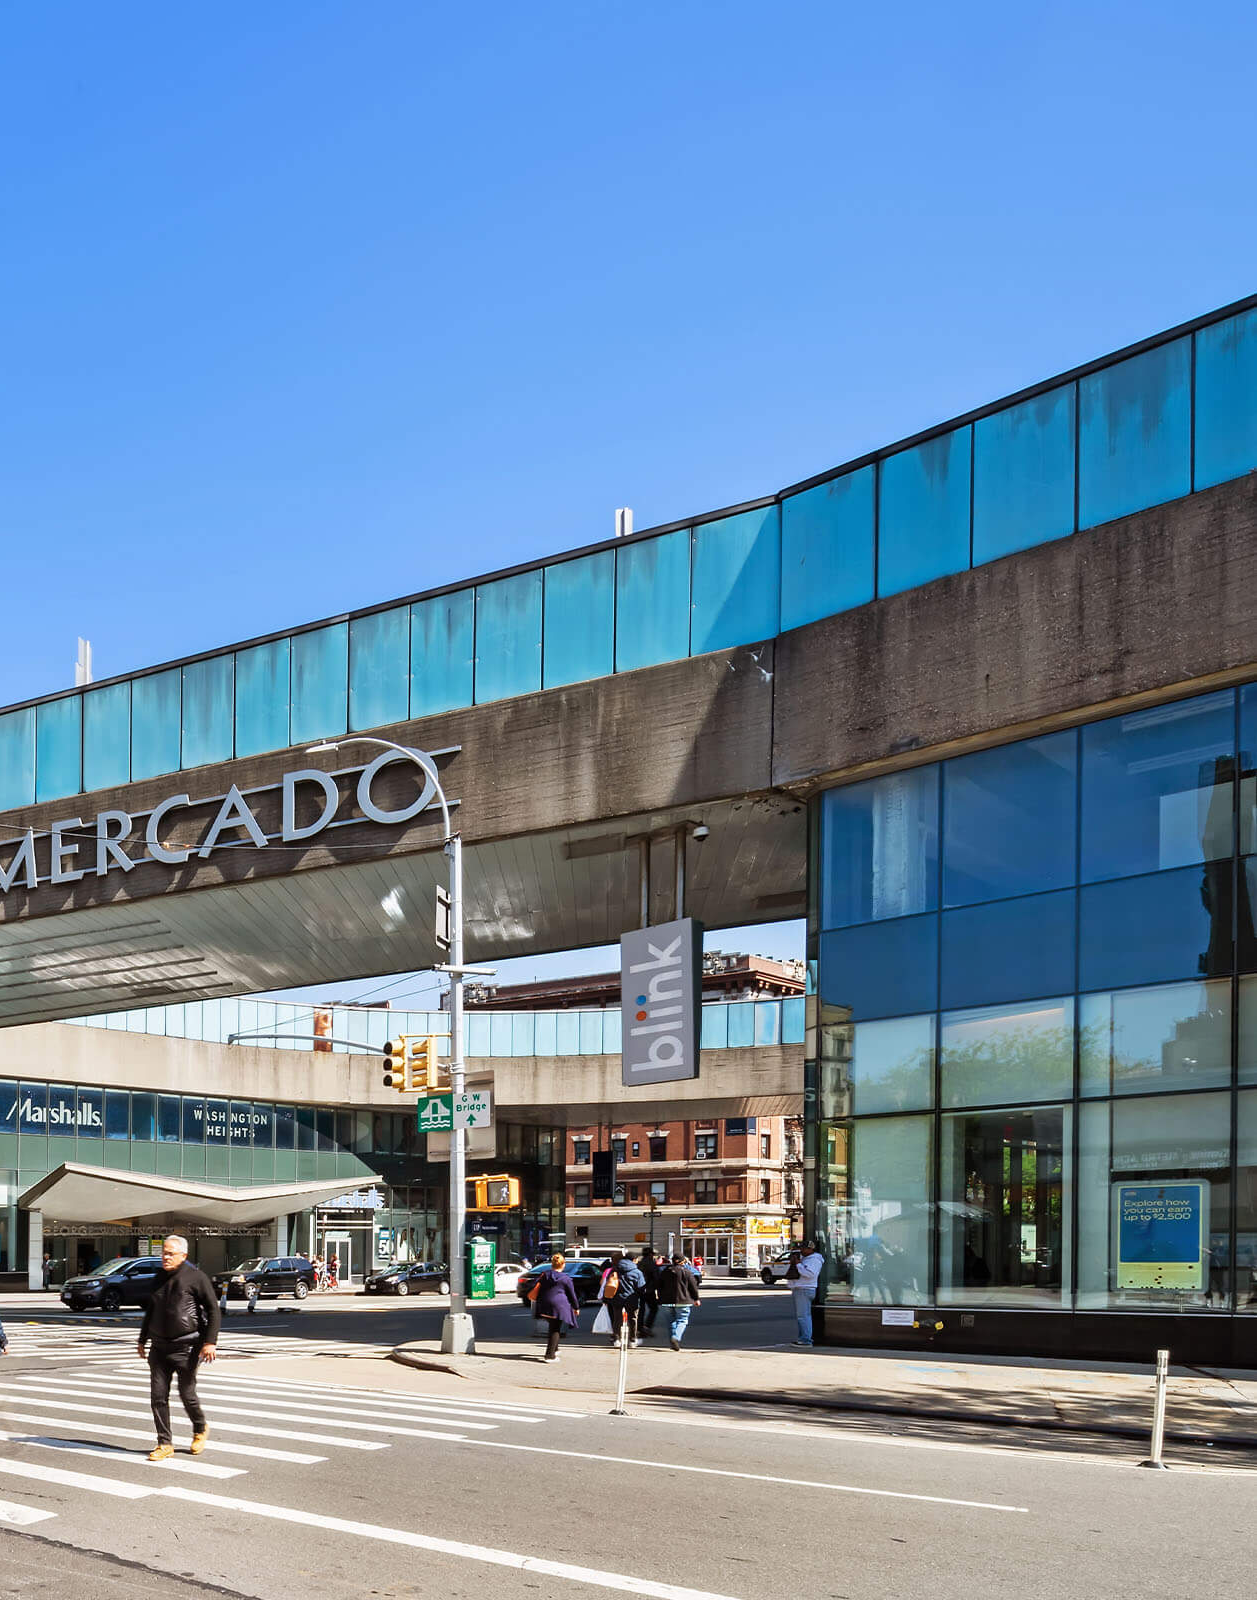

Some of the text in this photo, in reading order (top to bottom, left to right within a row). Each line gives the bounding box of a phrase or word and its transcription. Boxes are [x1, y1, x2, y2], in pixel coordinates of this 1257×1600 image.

[629, 935, 684, 1072] blink
[461, 1093, 481, 1102] G W
[456, 1103, 487, 1113] Bridge
[193, 1109, 268, 1125] WSHNGTON
[1124, 1200, 1164, 1208] Explore
[1124, 1207, 1144, 1215] you
[1124, 1214, 1139, 1222] up
